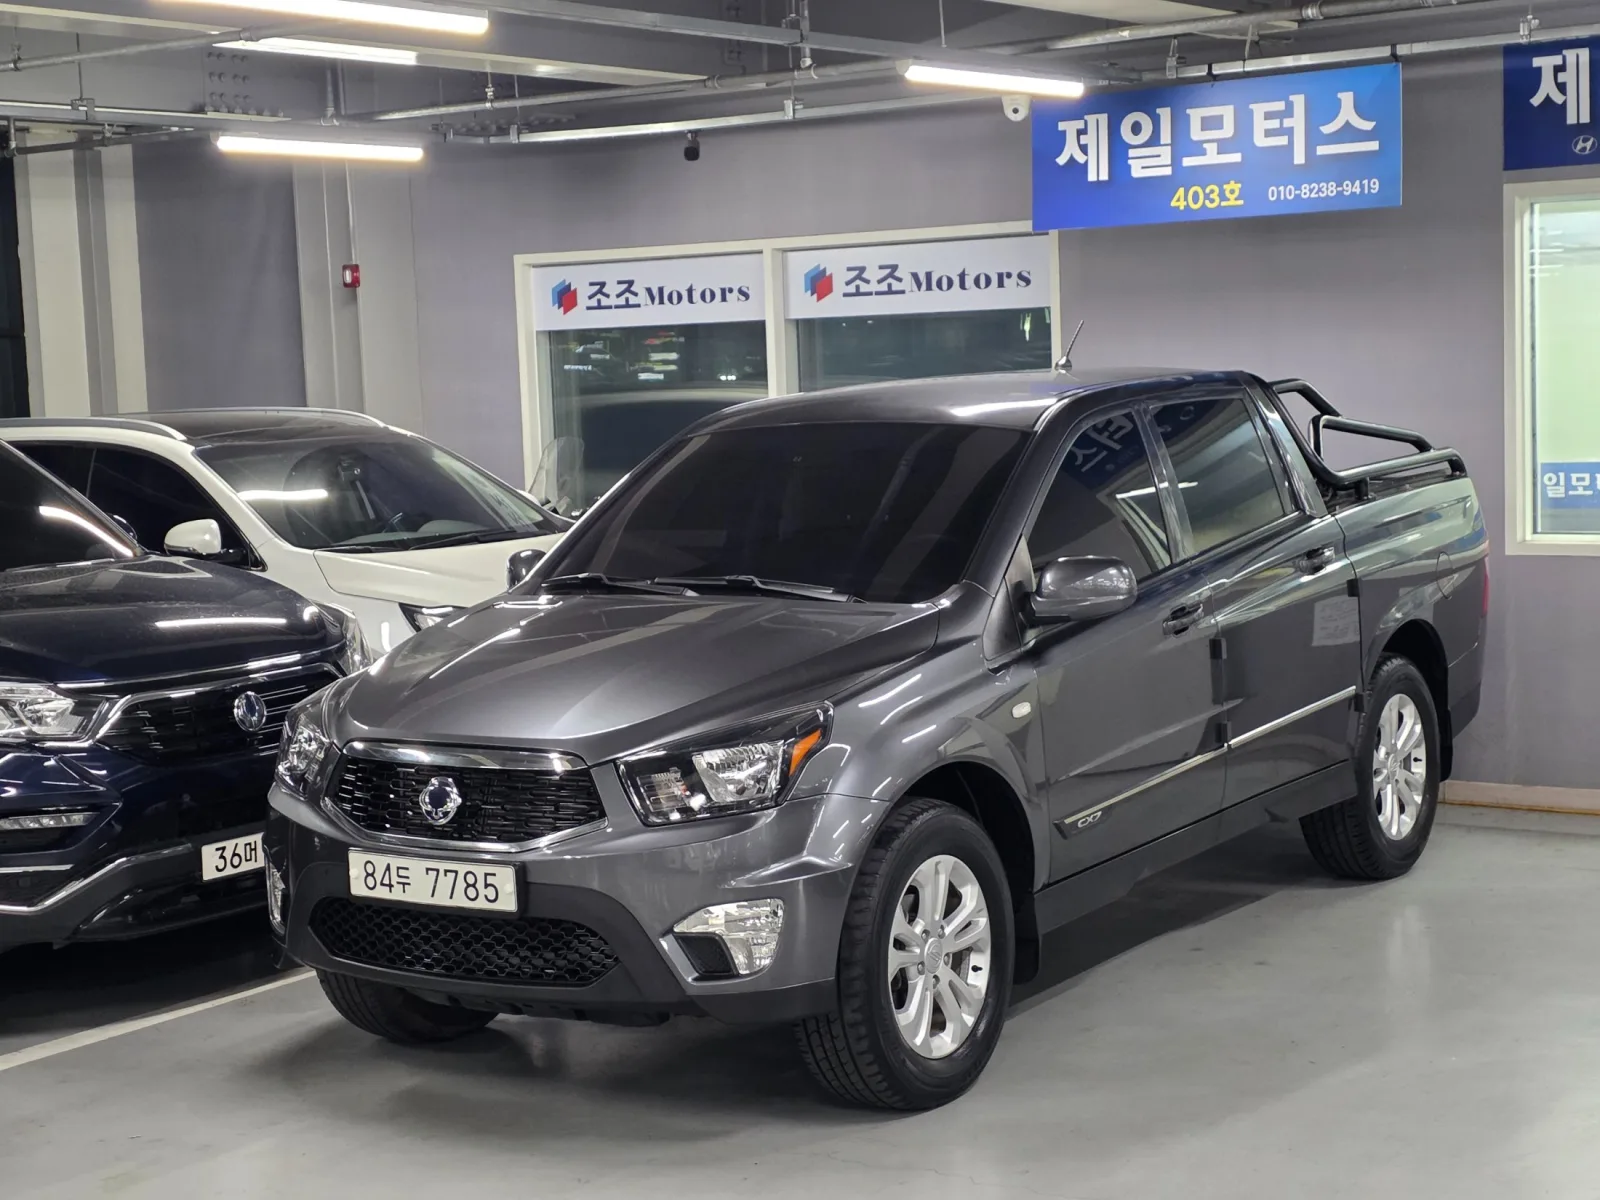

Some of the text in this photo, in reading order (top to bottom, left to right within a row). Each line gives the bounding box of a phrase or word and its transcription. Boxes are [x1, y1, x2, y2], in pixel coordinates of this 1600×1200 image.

[1529, 47, 1590, 124] 제
[1055, 91, 1380, 182] 제일모터스
[1171, 179, 1380, 211] 403호 010-8238-9419
[585, 279, 751, 311] 조조Motors
[842, 263, 1032, 298] 조조Motors
[215, 840, 257, 872] 36머
[363, 860, 500, 904] 84두 7785
